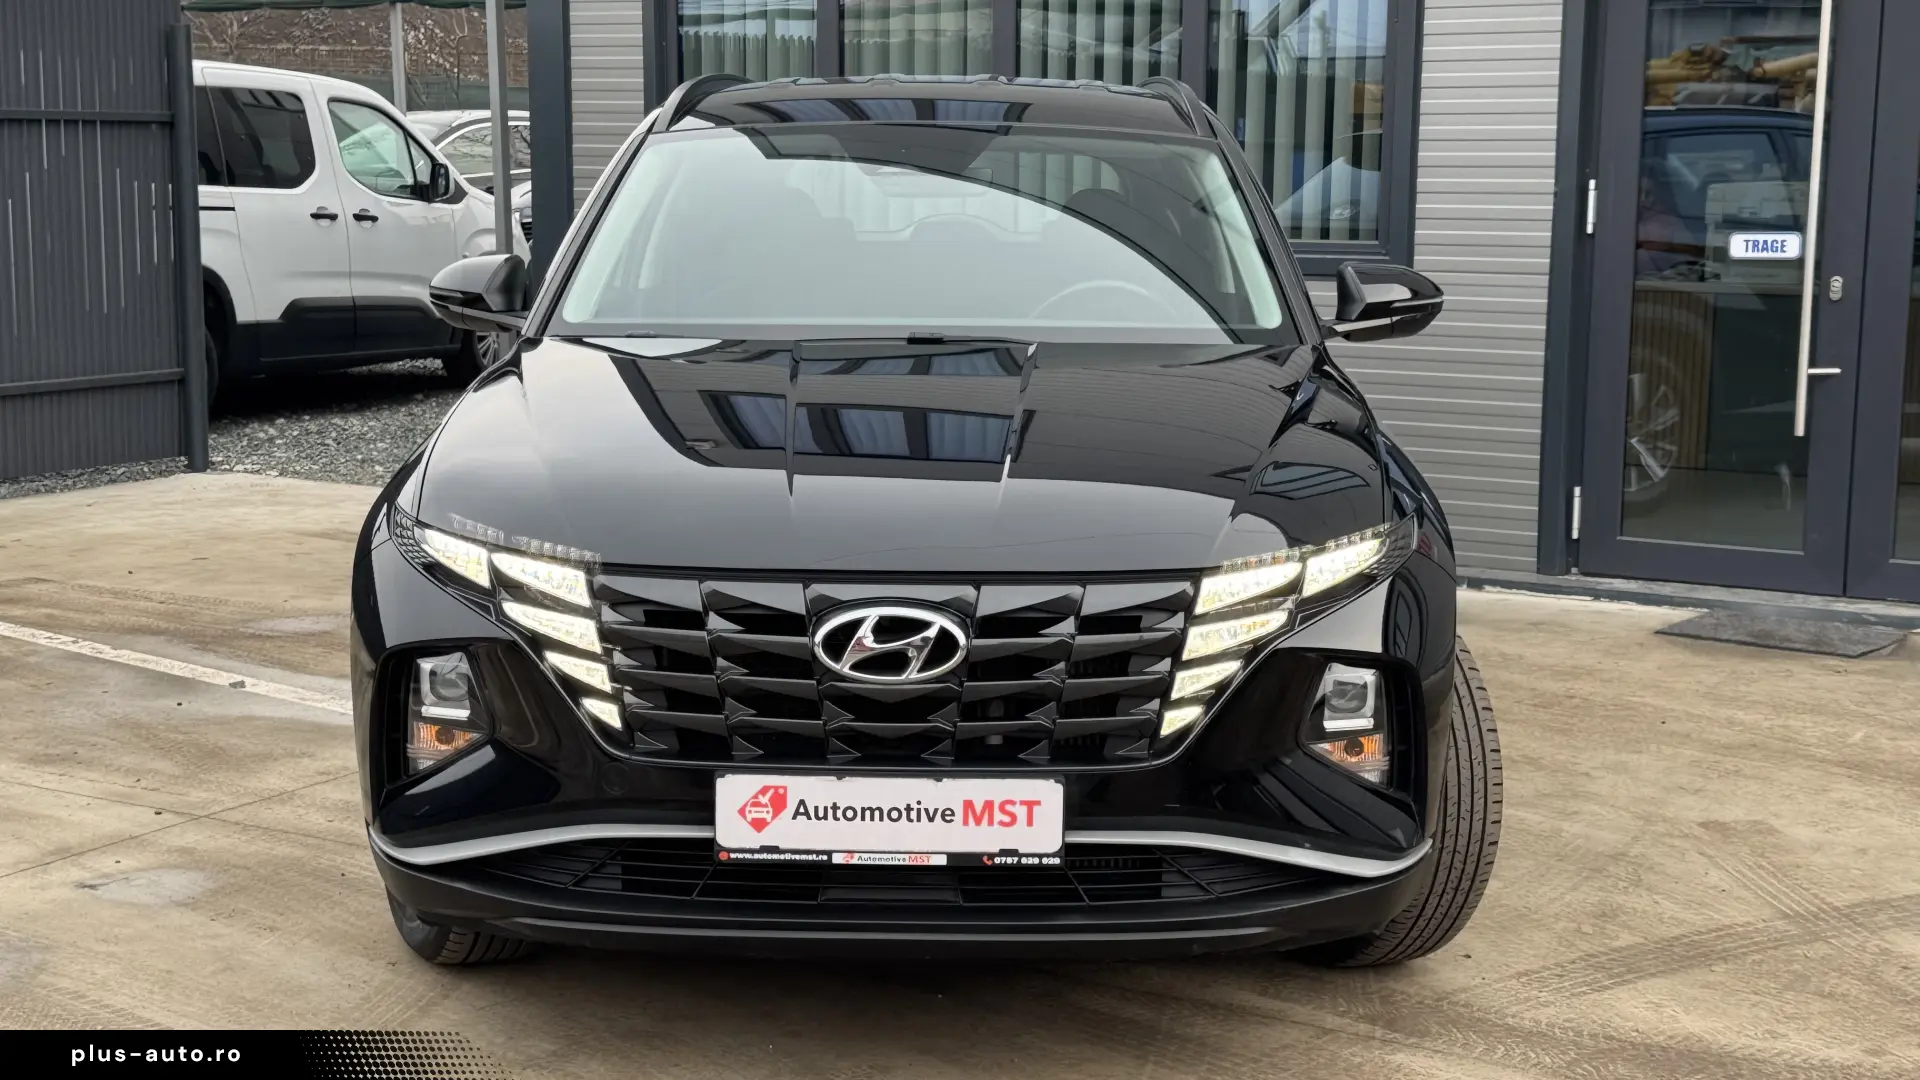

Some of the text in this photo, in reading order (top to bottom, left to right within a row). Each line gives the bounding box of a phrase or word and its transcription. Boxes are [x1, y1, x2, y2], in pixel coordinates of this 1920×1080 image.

[1743, 239, 1788, 254] TRAGE
[791, 798, 1042, 828] Automotive MST
[729, 852, 828, 861] www.automotivemst.ro
[857, 855, 932, 864] Automotive MST
